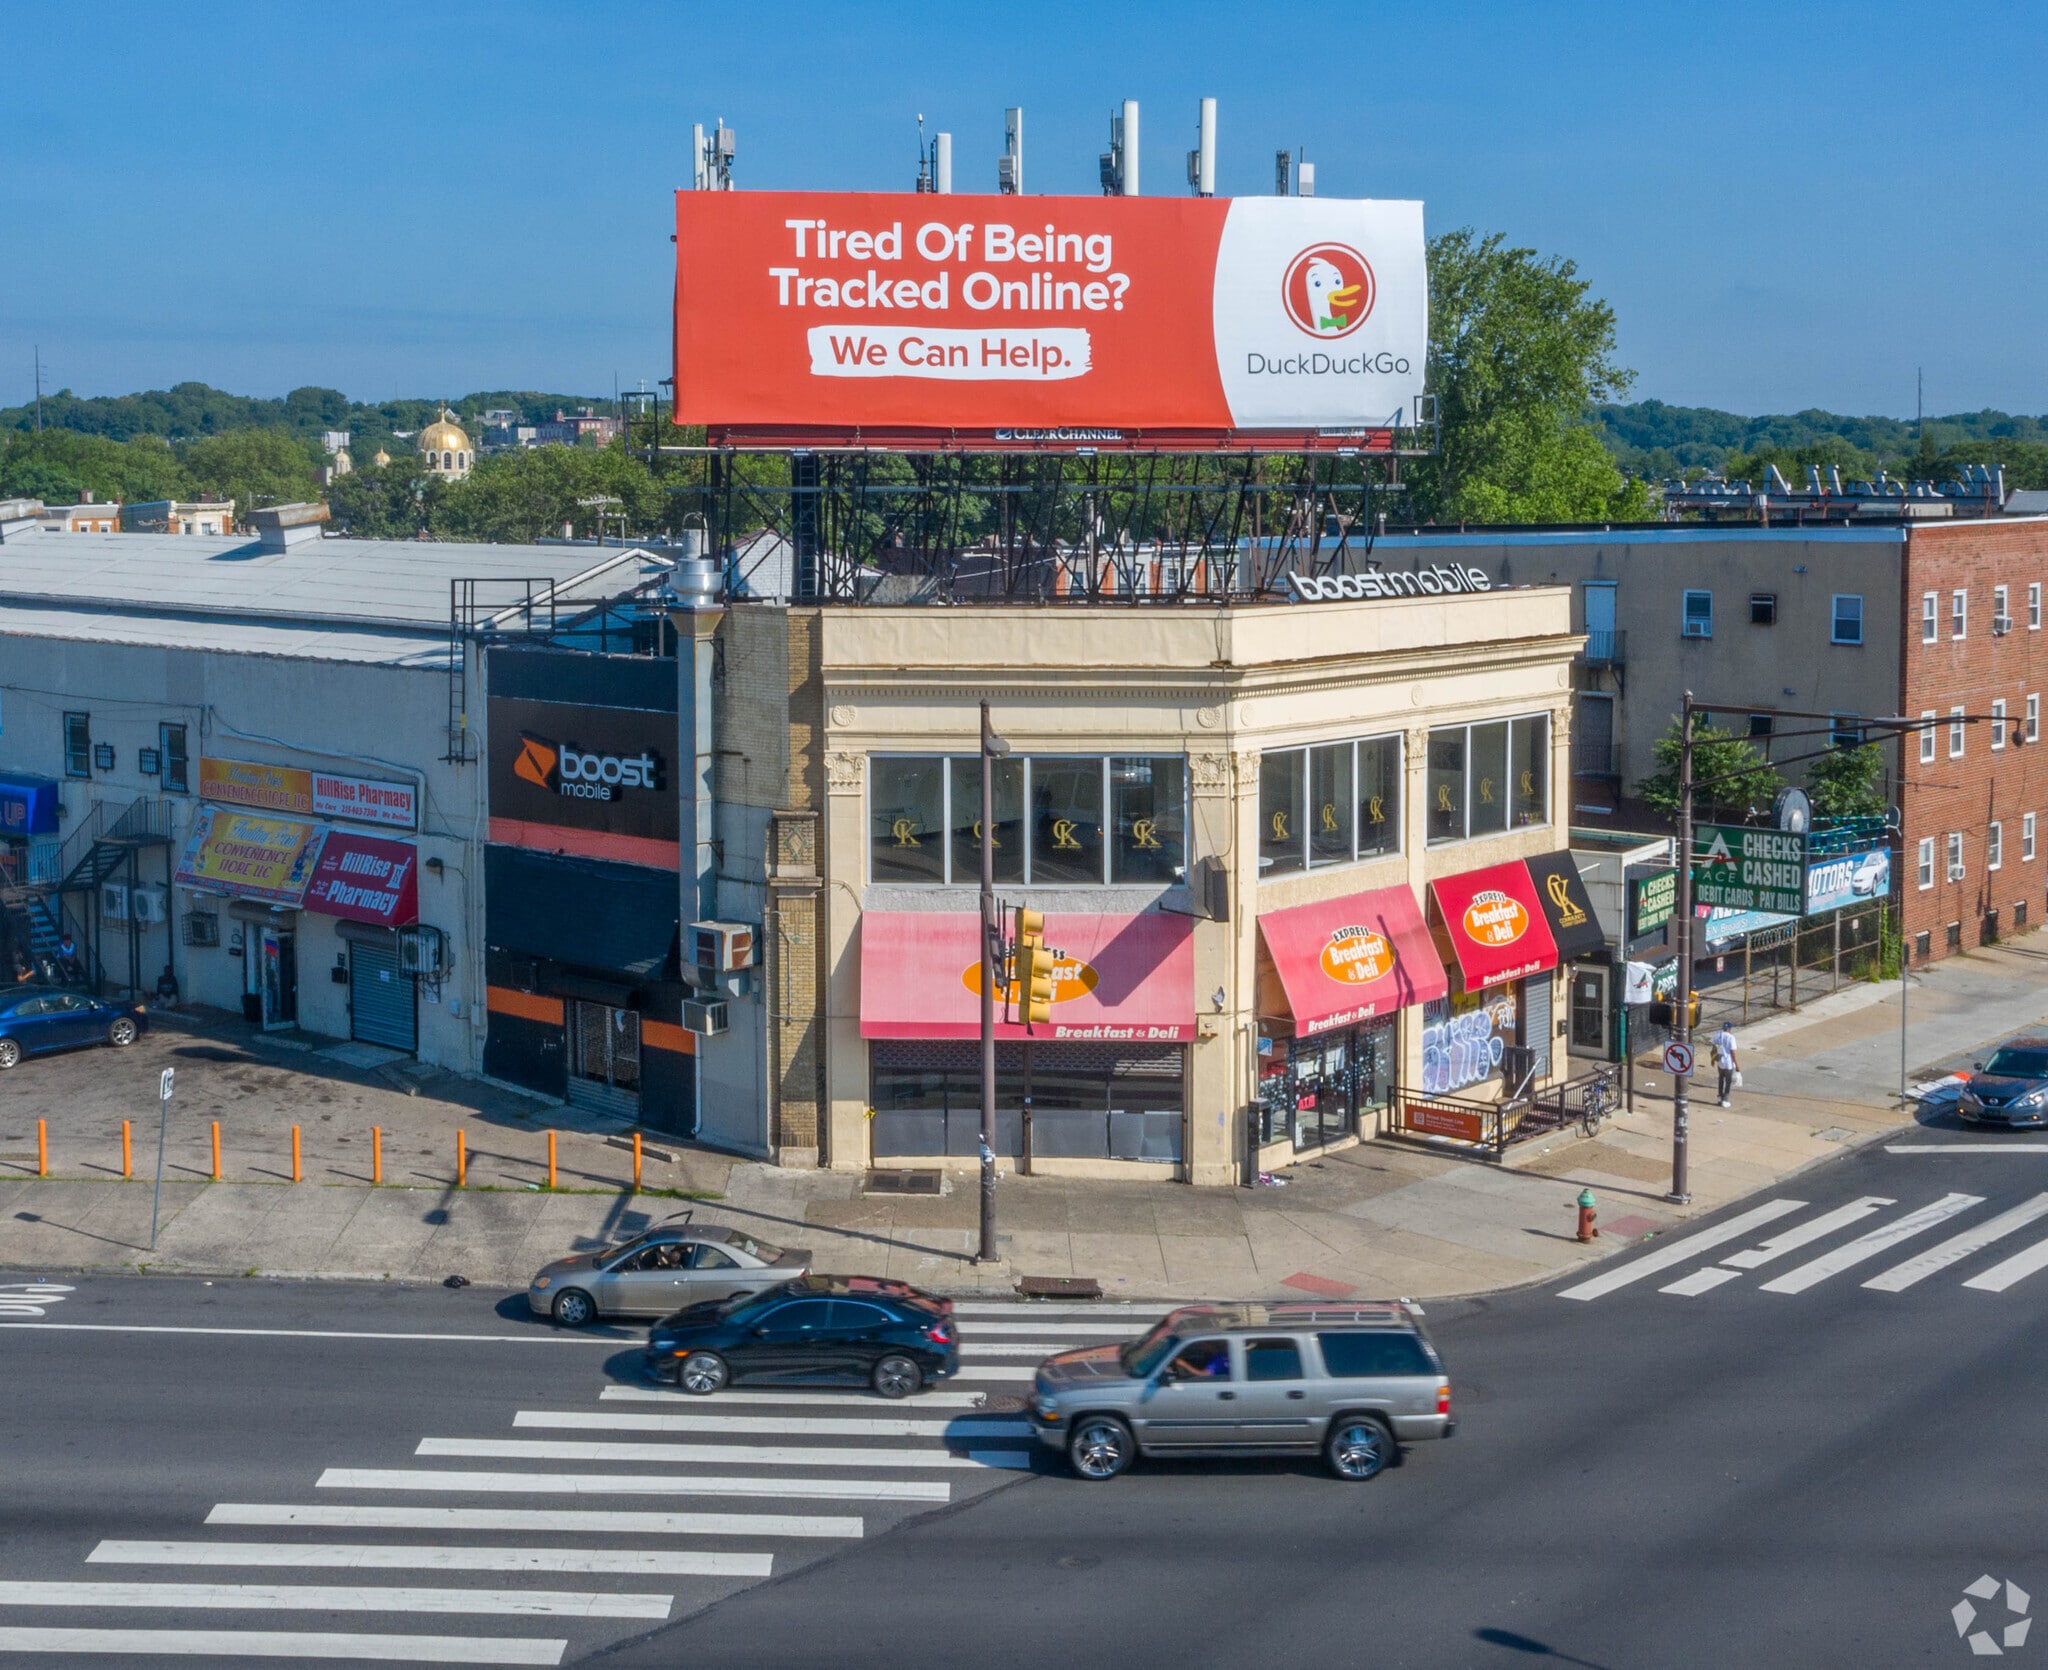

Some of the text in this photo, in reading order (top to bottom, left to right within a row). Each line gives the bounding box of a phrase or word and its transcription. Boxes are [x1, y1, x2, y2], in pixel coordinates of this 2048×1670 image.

[785, 219, 1112, 272] Tired Of Being
[769, 267, 1131, 311] Tracked Online?
[829, 335, 1071, 375] We Can Help.
[560, 744, 655, 789] boost
[317, 777, 412, 812] HillRise Pharmacy
[561, 782, 611, 800] mobile
[214, 841, 292, 865] CONVENIENCE
[1743, 833, 1801, 862] CHECKS
[340, 851, 391, 877] HillRise
[1743, 860, 1801, 889] CASHED
[1648, 873, 1675, 897] CHECKS
[1702, 871, 1737, 883] ACE
[325, 880, 399, 916] Pharmacy
[1473, 892, 1506, 906] EXPRESS
[1648, 888, 1675, 913] CASHED
[1698, 884, 1724, 903] DEBIT
[1725, 886, 1754, 907] CARDS
[1760, 891, 1776, 910] PAY
[1777, 892, 1801, 912] BILLS
[1471, 902, 1519, 927] Breakfast
[1333, 926, 1370, 943] EXPRESS
[1486, 920, 1514, 942] & Deli
[1329, 937, 1385, 966] Breakfast
[1347, 957, 1379, 981] & Deli
[1483, 966, 1521, 985] Breakfast
[1525, 960, 1541, 973] Deli
[1308, 1011, 1351, 1033] Breakfast
[1358, 1003, 1375, 1019] Deli
[1055, 1026, 1134, 1039] Breakfast
[1148, 1026, 1179, 1039] Deli
